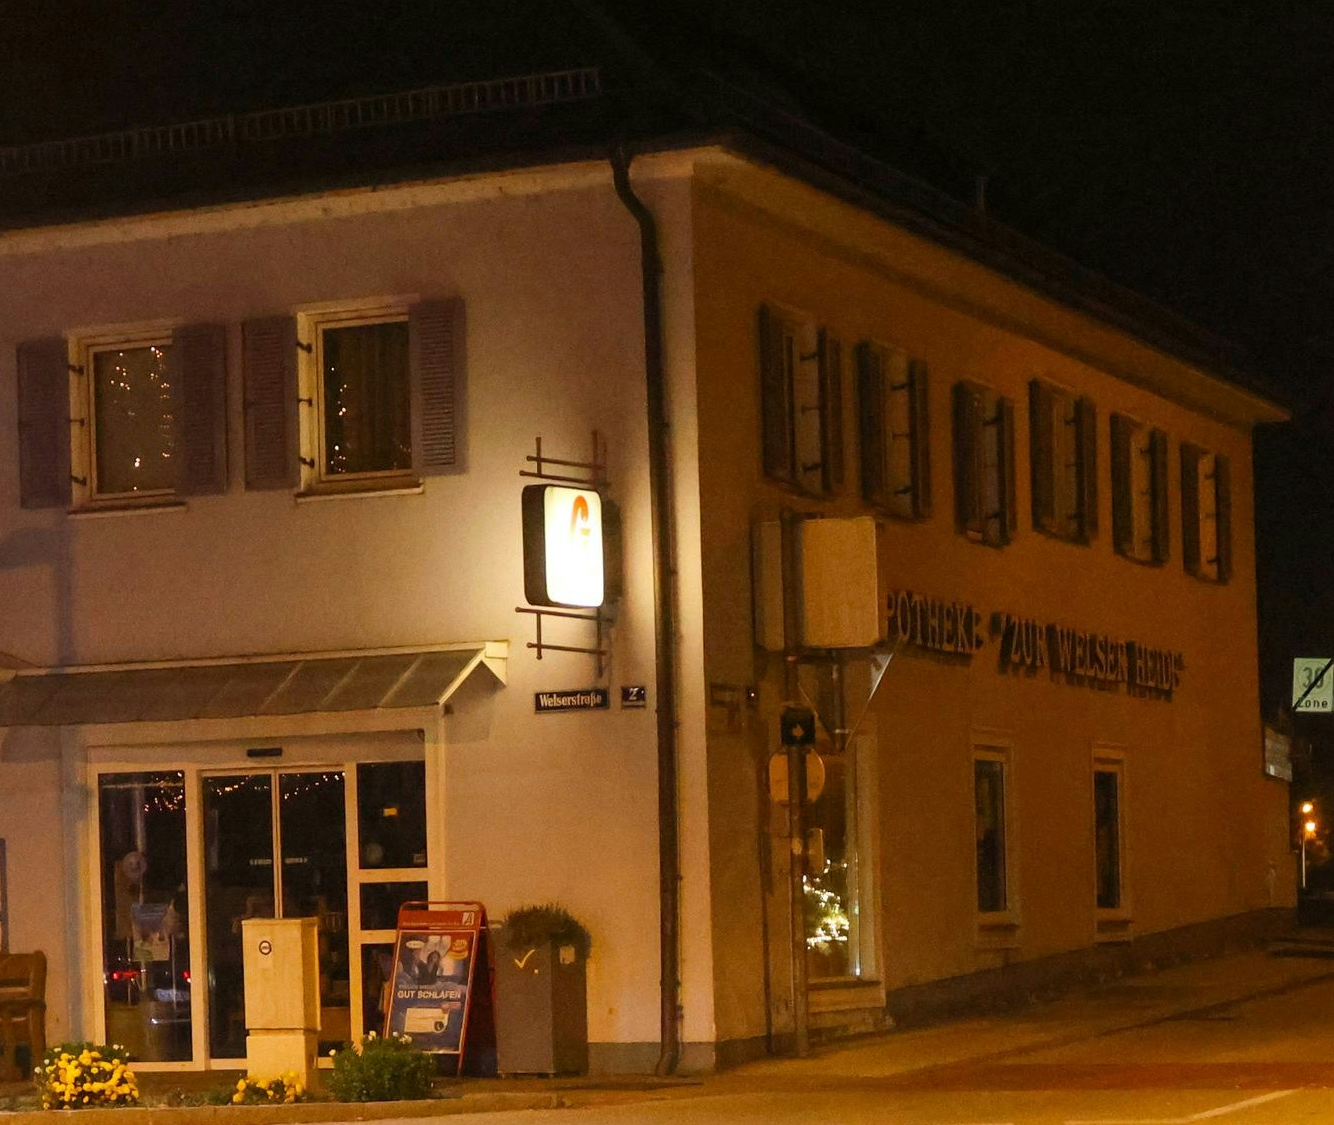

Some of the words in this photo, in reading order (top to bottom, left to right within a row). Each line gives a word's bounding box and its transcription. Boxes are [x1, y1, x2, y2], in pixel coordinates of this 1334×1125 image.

[886, 589, 983, 655] POTHEKE
[1302, 666, 1324, 689] 30
[539, 691, 603, 708] Welserstraße
[397, 990, 415, 999] GUT
[417, 989, 461, 999] SCHLAFEN
